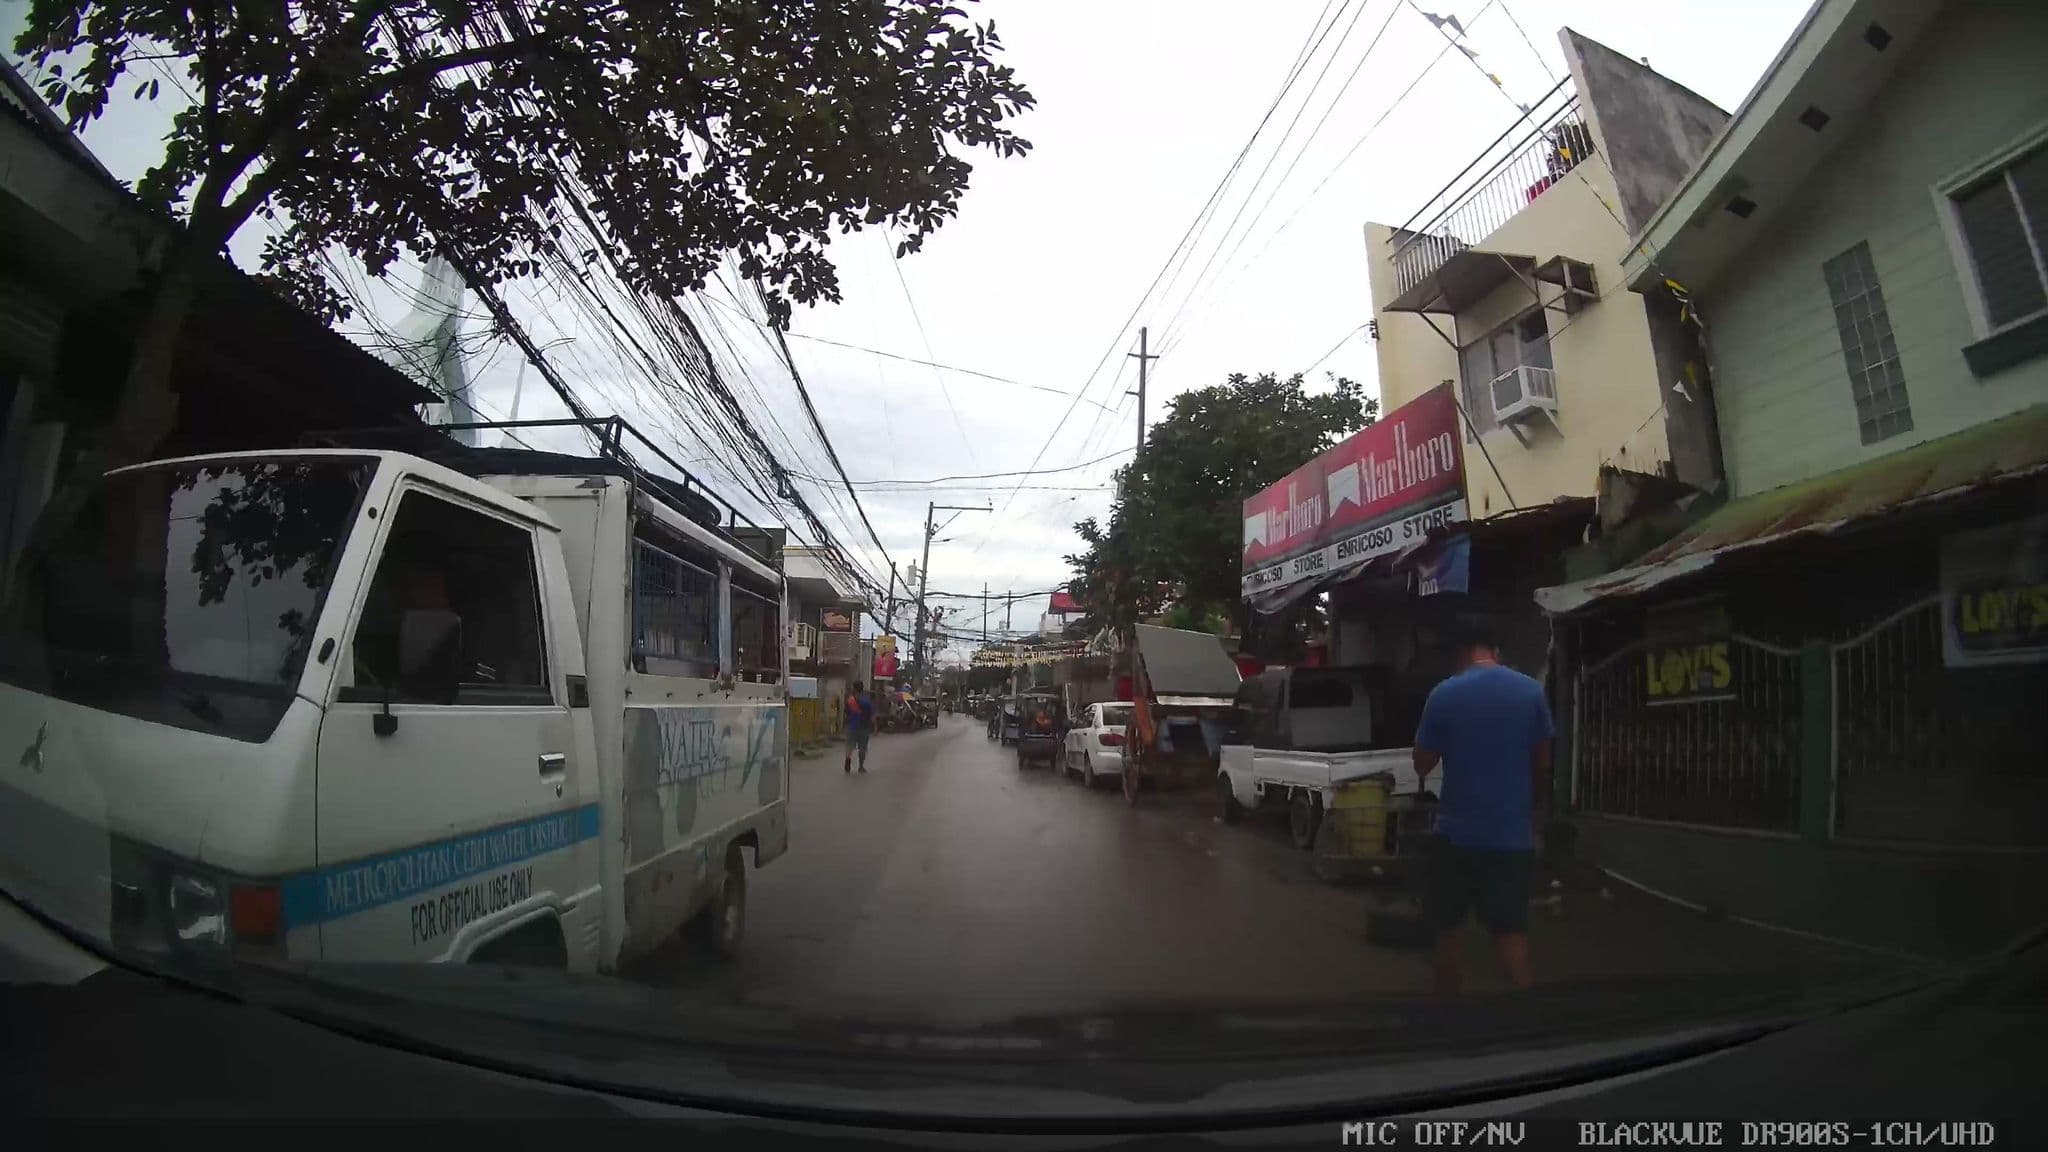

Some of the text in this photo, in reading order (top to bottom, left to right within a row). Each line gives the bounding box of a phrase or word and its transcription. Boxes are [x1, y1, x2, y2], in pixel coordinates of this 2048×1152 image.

[1361, 420, 1454, 505] Marlboro
[1265, 480, 1322, 546] Marlboro
[1337, 505, 1454, 560] ENRICOSO STORE
[1246, 552, 1324, 586] RICOSO STORE
[658, 720, 718, 770] WATER
[326, 843, 451, 913] METROPOLITAN
[453, 836, 487, 876] CEBU
[489, 827, 527, 864] WATER
[411, 865, 533, 945] FOR OFFICIAL USE ONLY
